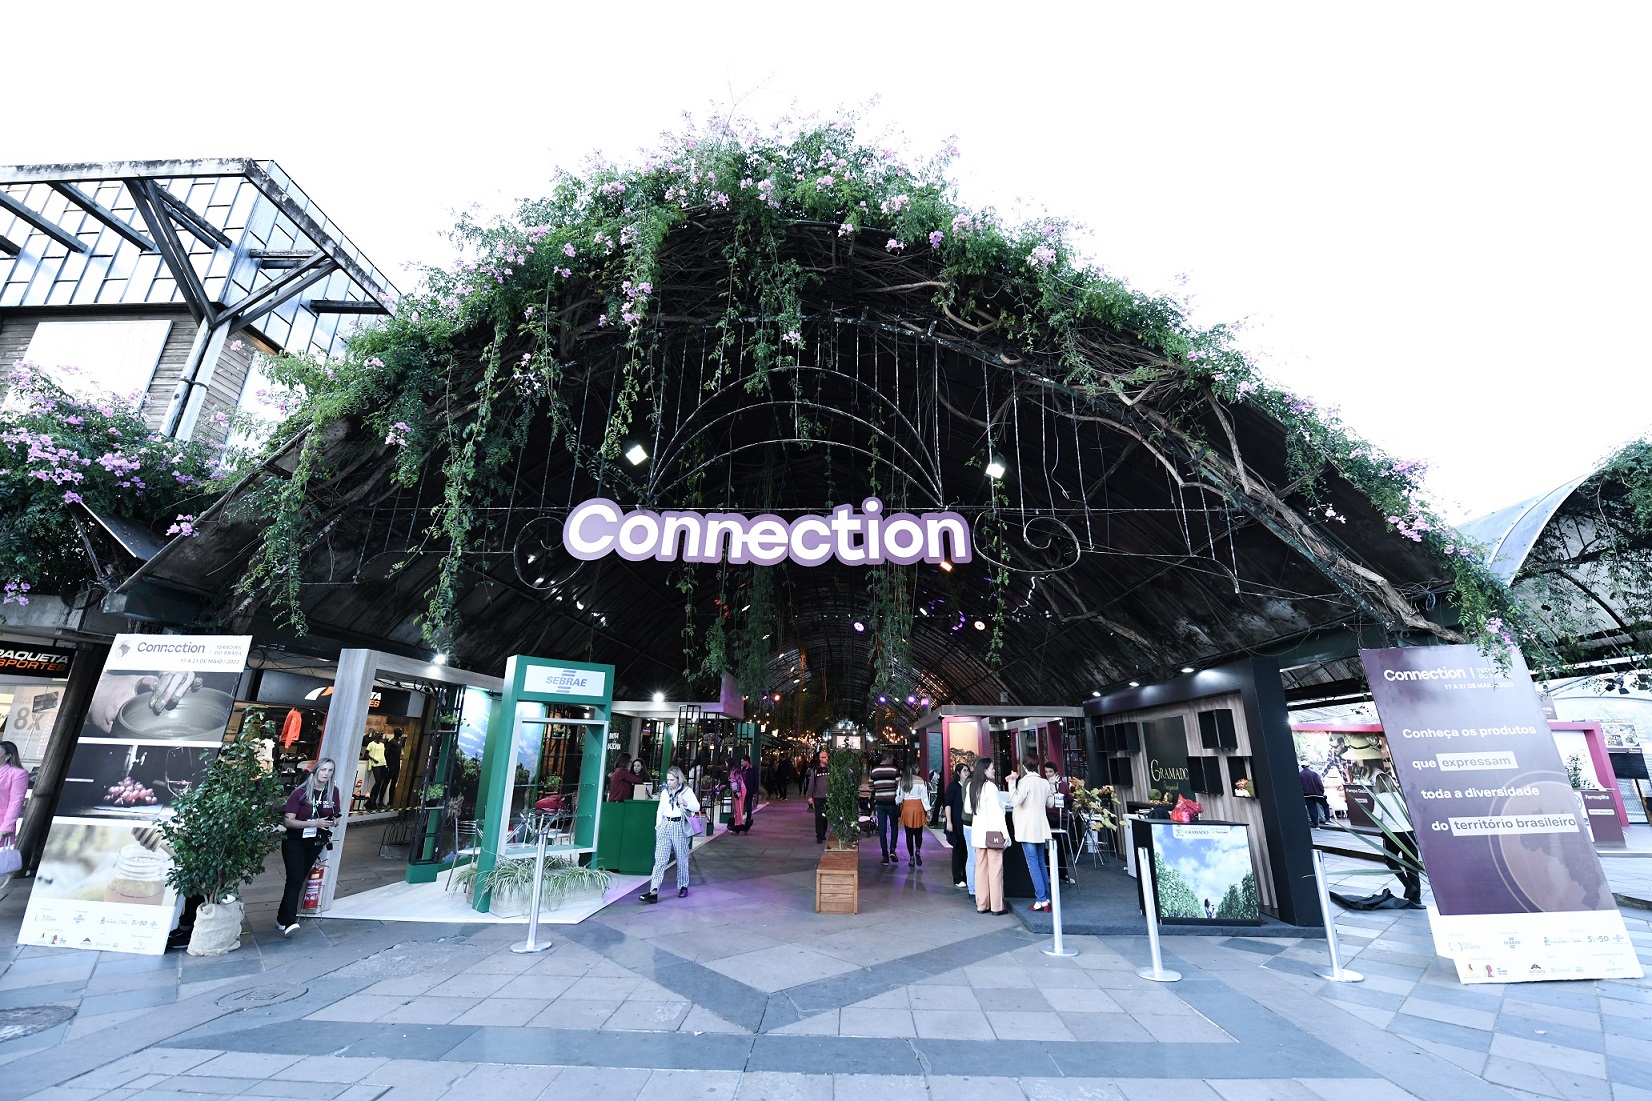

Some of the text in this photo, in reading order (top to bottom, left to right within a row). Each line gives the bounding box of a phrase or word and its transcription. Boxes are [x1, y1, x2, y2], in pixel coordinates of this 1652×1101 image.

[566, 498, 968, 562] Connection
[1383, 666, 1467, 681] Connection
[545, 676, 588, 687] SEBRAE
[1402, 725, 1537, 739] Conheça os produtos
[1150, 759, 1190, 781] GRAMADO
[1412, 757, 1511, 770] que expressam
[1421, 785, 1540, 799] toda a diversidade
[1431, 816, 1576, 831] do território brasileiro
